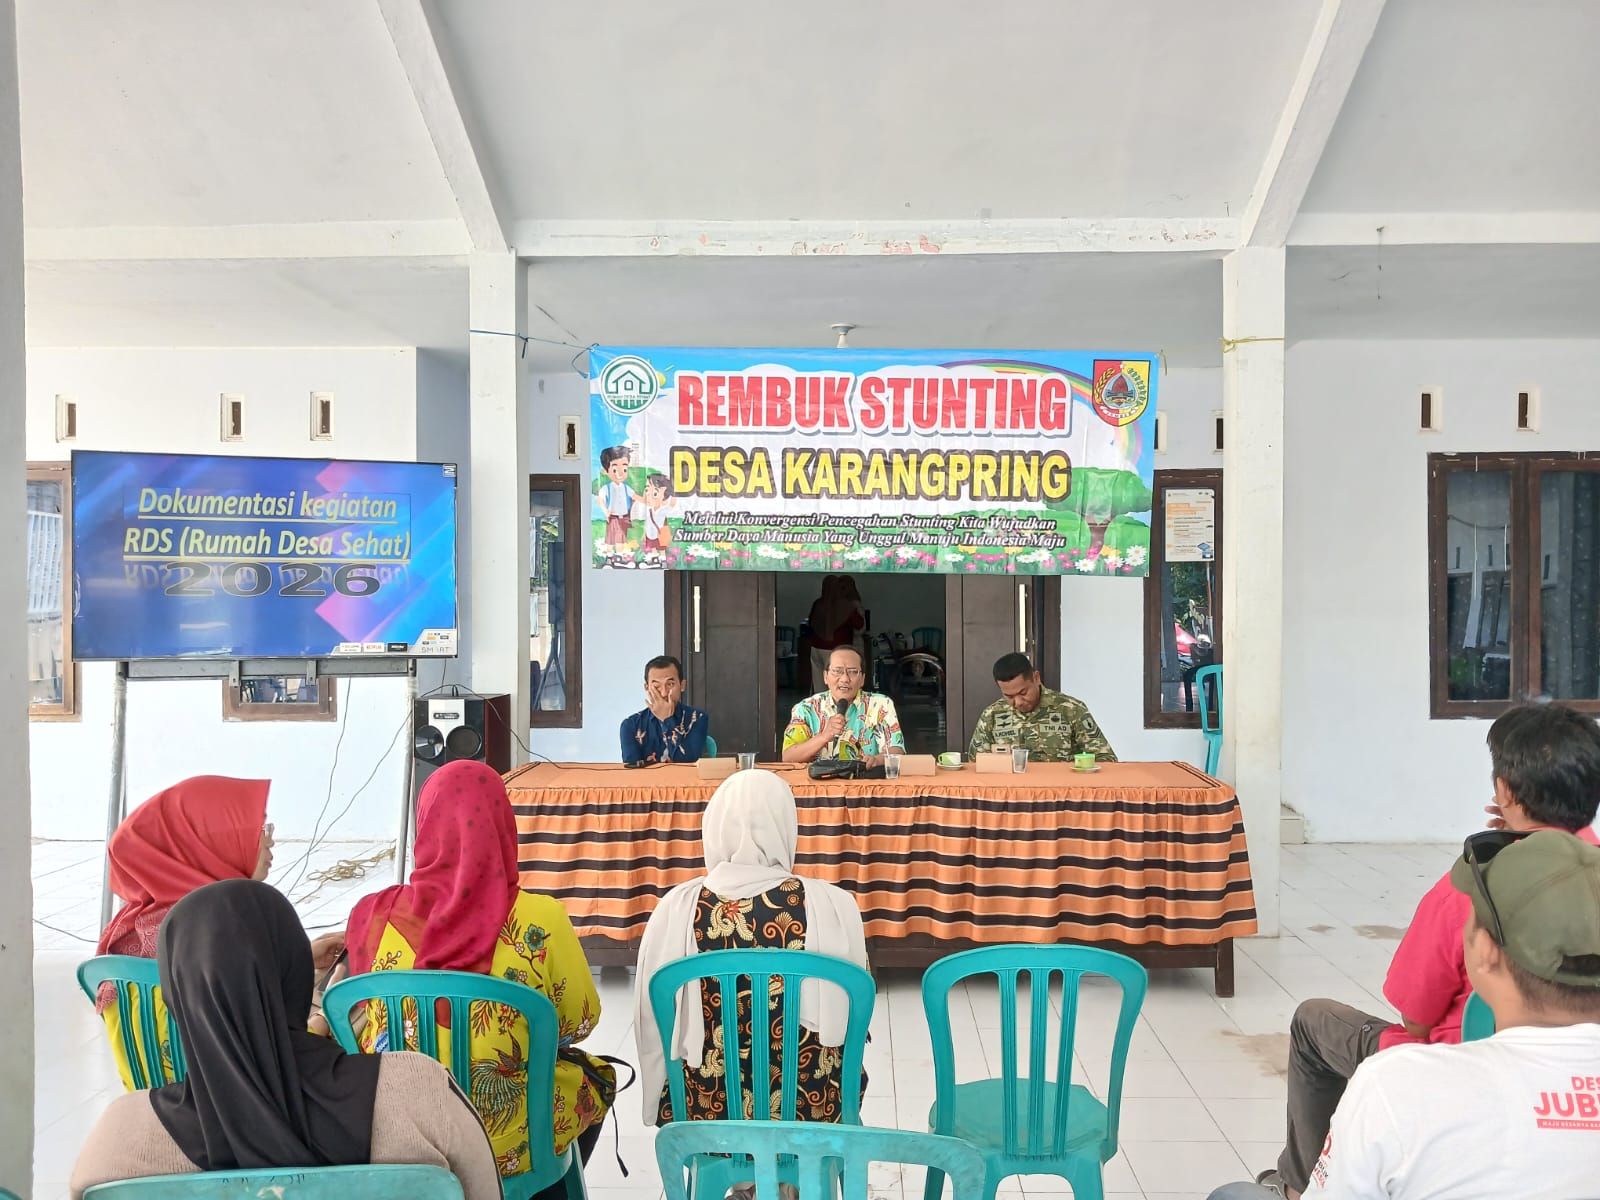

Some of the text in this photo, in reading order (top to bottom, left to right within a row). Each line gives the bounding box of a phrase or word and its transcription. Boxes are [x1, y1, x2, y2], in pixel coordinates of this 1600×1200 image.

[678, 375, 1067, 431] REMBUK STUNTING
[673, 450, 1068, 499] DESA KARANGPRING
[138, 487, 397, 521] Dokumentasi kegiatan
[684, 511, 1056, 531] Melalui Konvergensi Pencegahan Stunting Kita Wujudkan
[123, 526, 411, 560] RDS (Rumah Desa Sehat)
[674, 529, 1066, 549] Sumber Daya Manusia Yang Unggul Menuju Indonesia Maju
[164, 561, 382, 597] 2026
